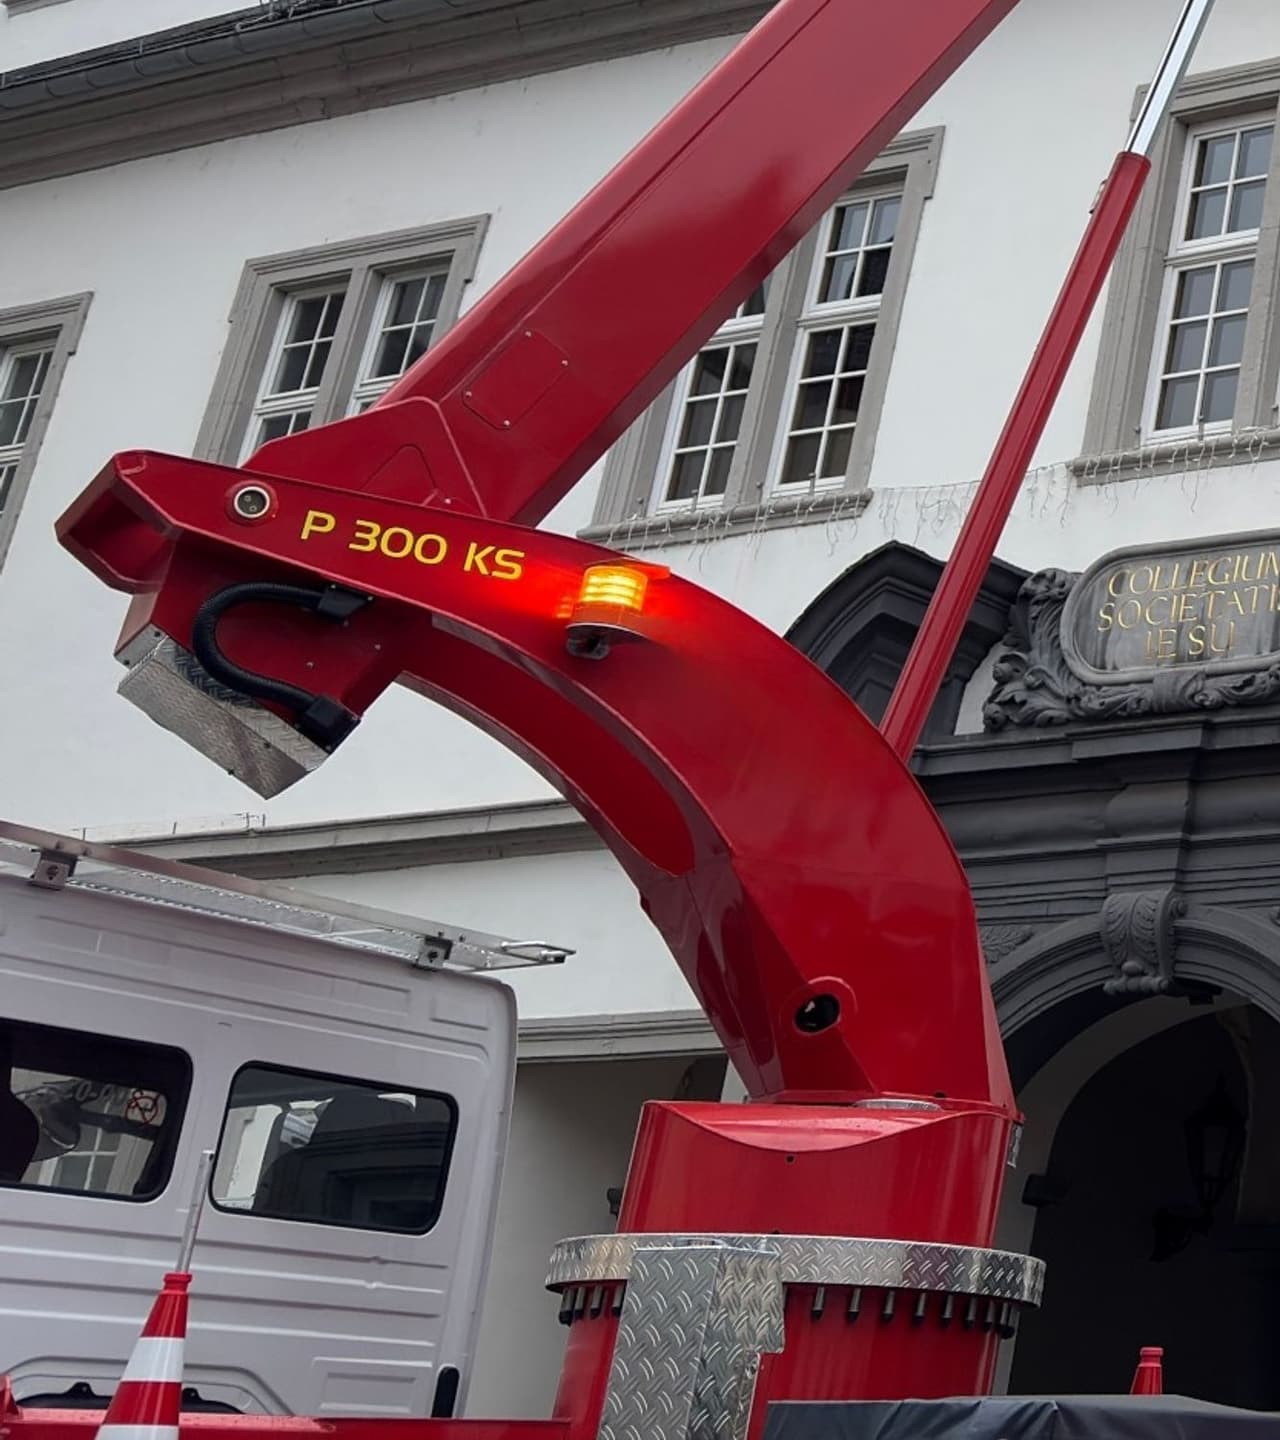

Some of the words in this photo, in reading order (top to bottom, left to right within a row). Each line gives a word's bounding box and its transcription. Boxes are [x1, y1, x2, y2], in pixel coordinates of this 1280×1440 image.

[299, 509, 336, 541] P
[348, 519, 449, 566] 300
[463, 542, 525, 581] KS
